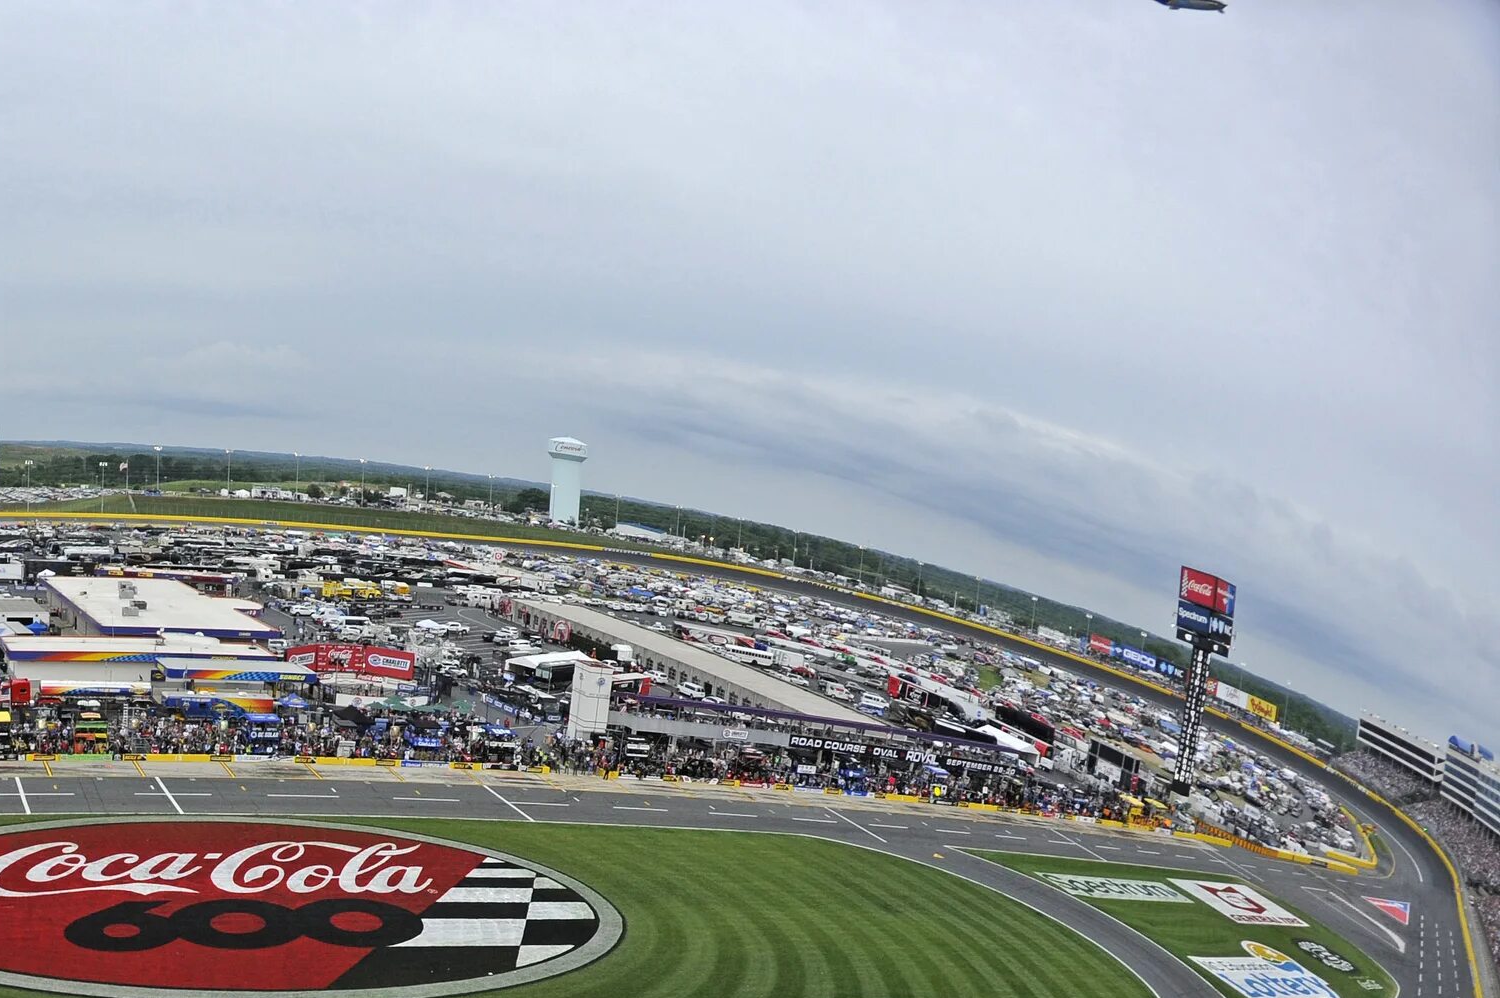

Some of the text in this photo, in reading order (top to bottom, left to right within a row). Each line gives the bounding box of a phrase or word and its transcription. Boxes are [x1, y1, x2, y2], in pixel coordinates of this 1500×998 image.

[1178, 606, 1208, 624] Spectrum
[1123, 647, 1157, 668] GEICO
[791, 737, 823, 748] ROAD
[824, 740, 867, 754] COURSE
[873, 748, 899, 758] OVAL
[946, 758, 992, 773] SEPTEMBER
[1042, 873, 1178, 897] Spectrum
[64, 900, 424, 952] 600
[1229, 913, 1278, 923] GENERAL
